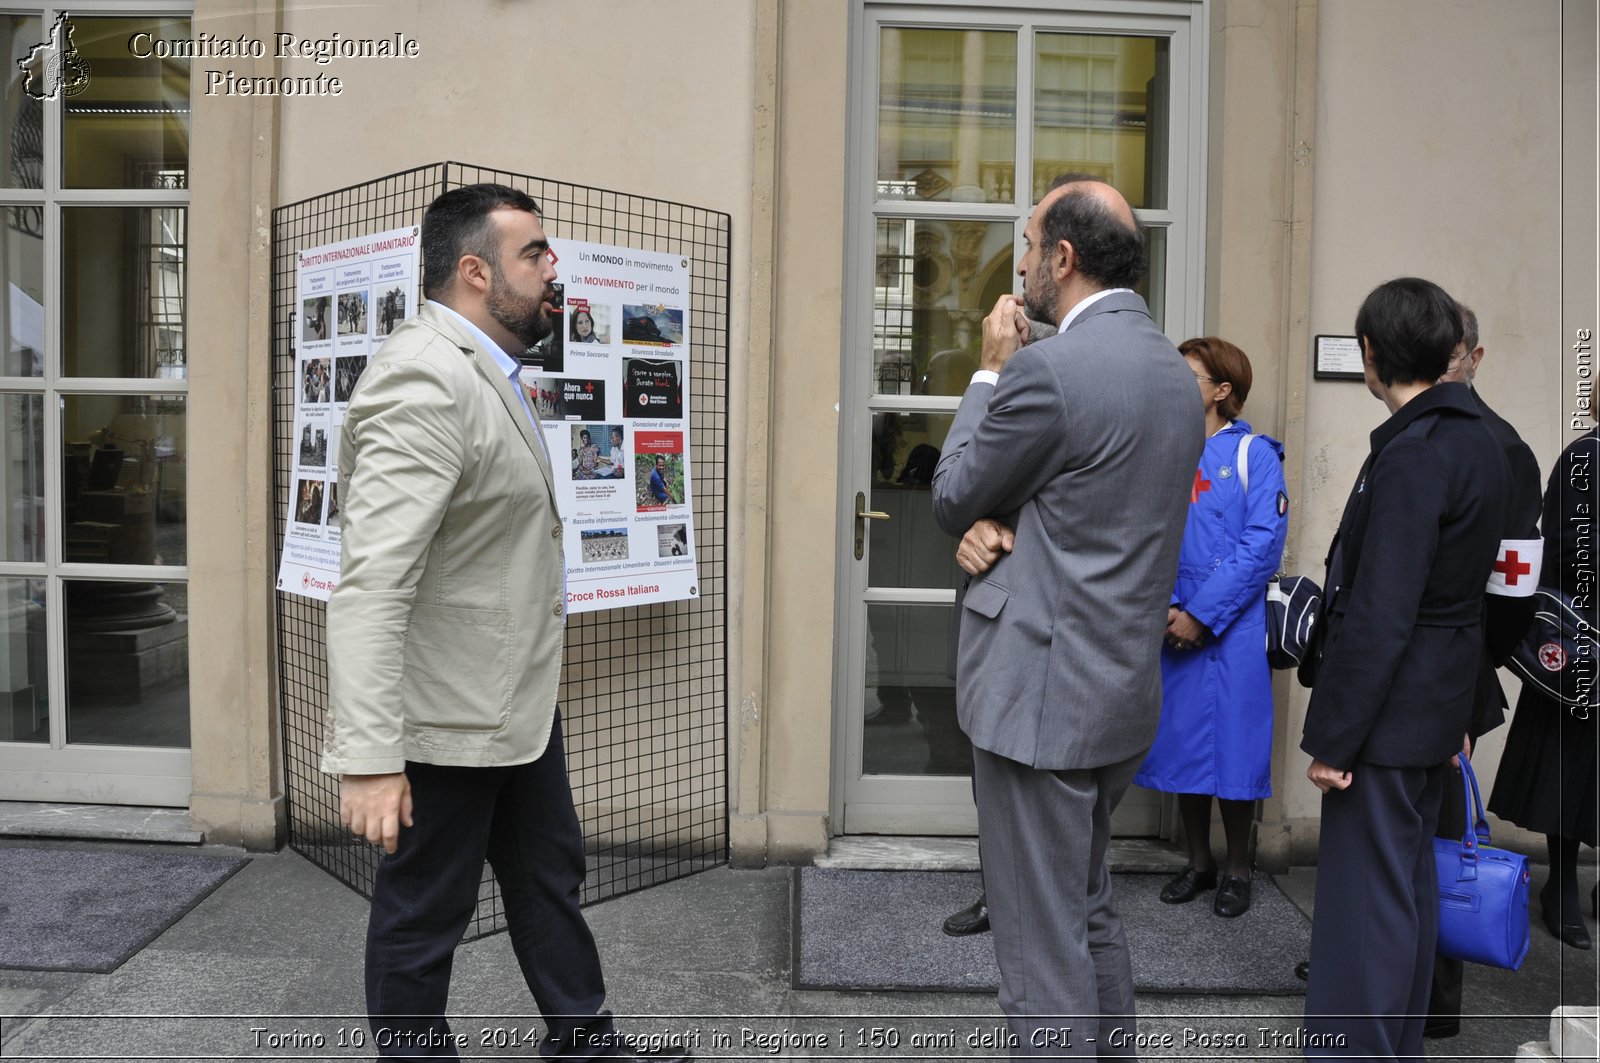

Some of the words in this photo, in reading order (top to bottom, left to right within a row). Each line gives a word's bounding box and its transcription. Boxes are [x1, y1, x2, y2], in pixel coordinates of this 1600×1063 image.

[302, 254, 322, 268] DIRITTO
[322, 244, 370, 262] INTERNAZIONALE
[372, 236, 415, 254] UMANITARIO
[580, 252, 590, 260] Un
[592, 253, 624, 266] MONDO
[625, 258, 633, 266] in
[634, 260, 673, 272] movimento
[571, 275, 582, 284] Un
[584, 276, 634, 290] MOVIMENTO
[636, 284, 648, 292] per
[650, 284, 654, 292] il
[655, 285, 680, 295] mondo
[564, 382, 580, 392] Ahora
[564, 392, 575, 402] que
[596, 516, 628, 524] informazioni
[585, 564, 622, 573] Internazionale
[622, 561, 650, 570] Umanitario
[311, 578, 326, 590] Croce
[566, 592, 594, 602] Croce
[596, 588, 625, 599] Rossa
[628, 584, 660, 596] Italiana
